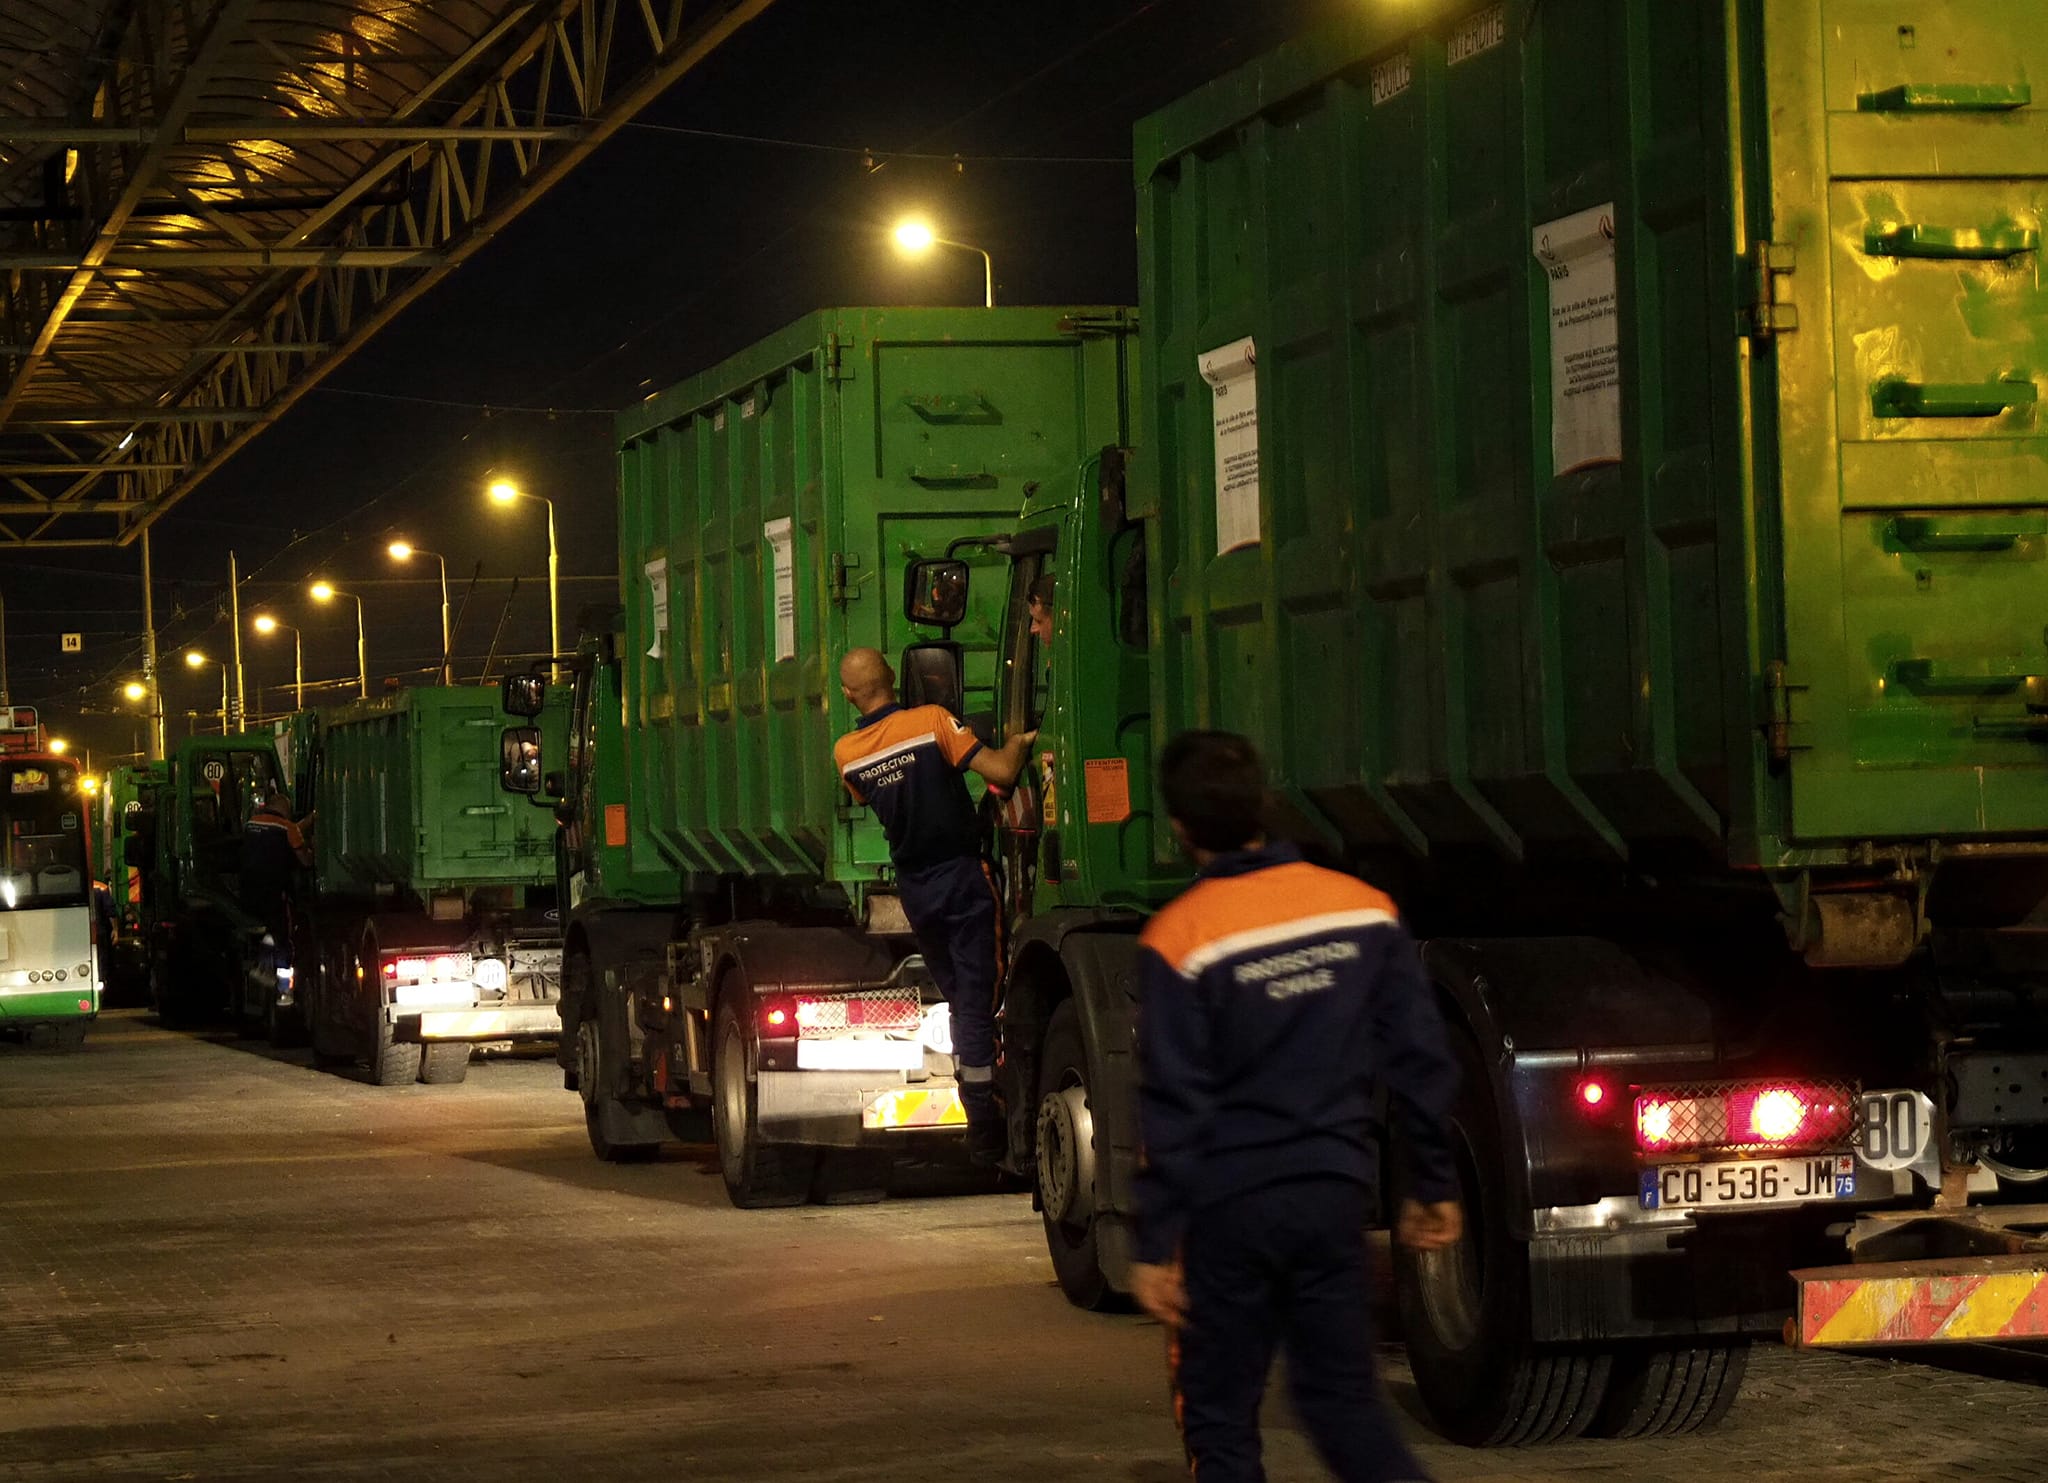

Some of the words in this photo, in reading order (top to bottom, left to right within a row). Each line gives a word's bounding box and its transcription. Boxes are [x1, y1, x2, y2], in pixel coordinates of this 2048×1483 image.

[1449, 3, 1504, 64] INTERDITE
[1550, 264, 1568, 280] PARIS
[66, 637, 77, 647] 14
[208, 764, 221, 778] 80
[859, 751, 916, 780] PROTECTION
[1232, 941, 1360, 985] PROTECTION
[1264, 967, 1337, 1001] CIVILE
[1865, 1094, 1917, 1159] 80
[1645, 1192, 1652, 1203] F
[1836, 1177, 1853, 1193] 75
